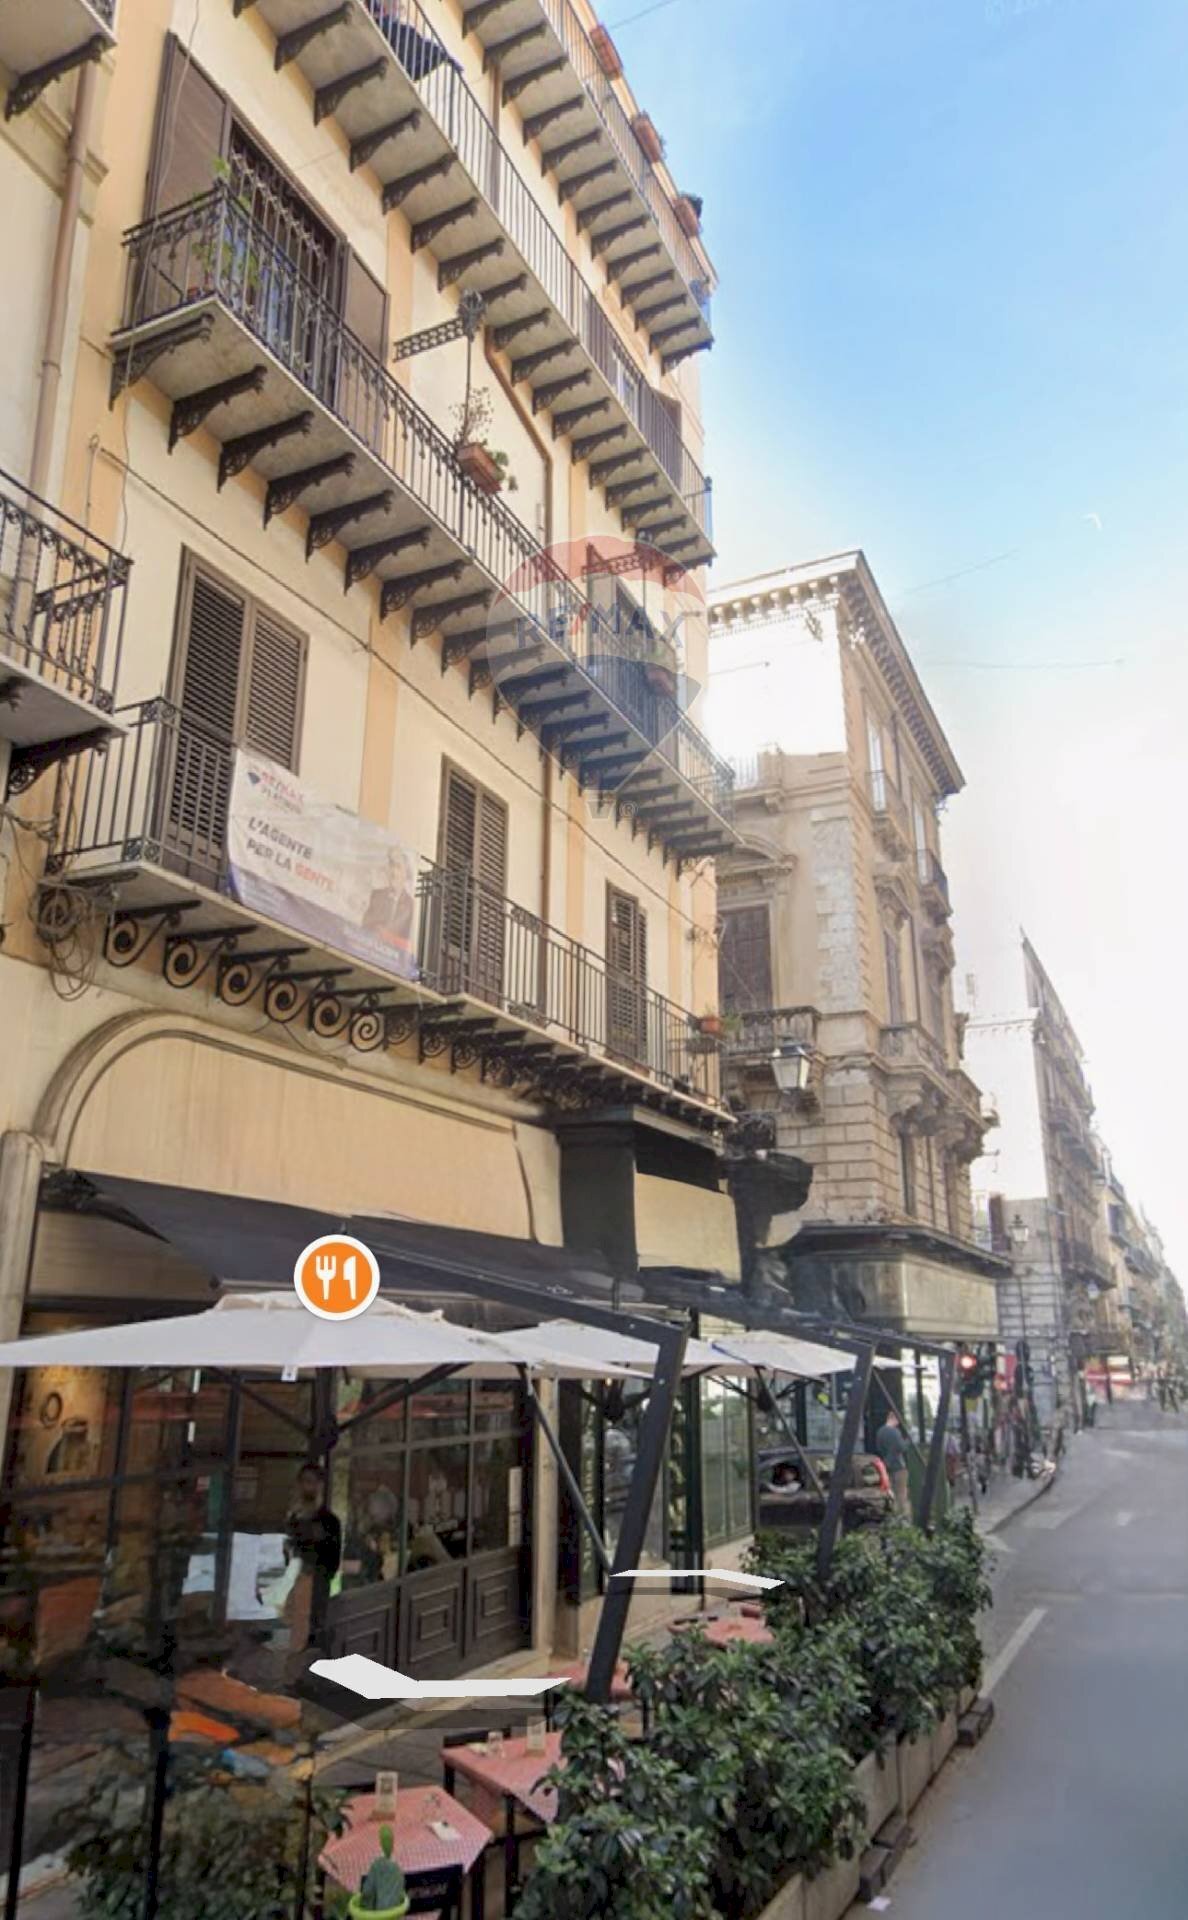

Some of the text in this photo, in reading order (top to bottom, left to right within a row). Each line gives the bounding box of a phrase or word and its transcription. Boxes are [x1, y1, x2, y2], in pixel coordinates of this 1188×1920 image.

[248, 817, 313, 860] L'AGENTE
[246, 838, 336, 892] PER LA GENTE
